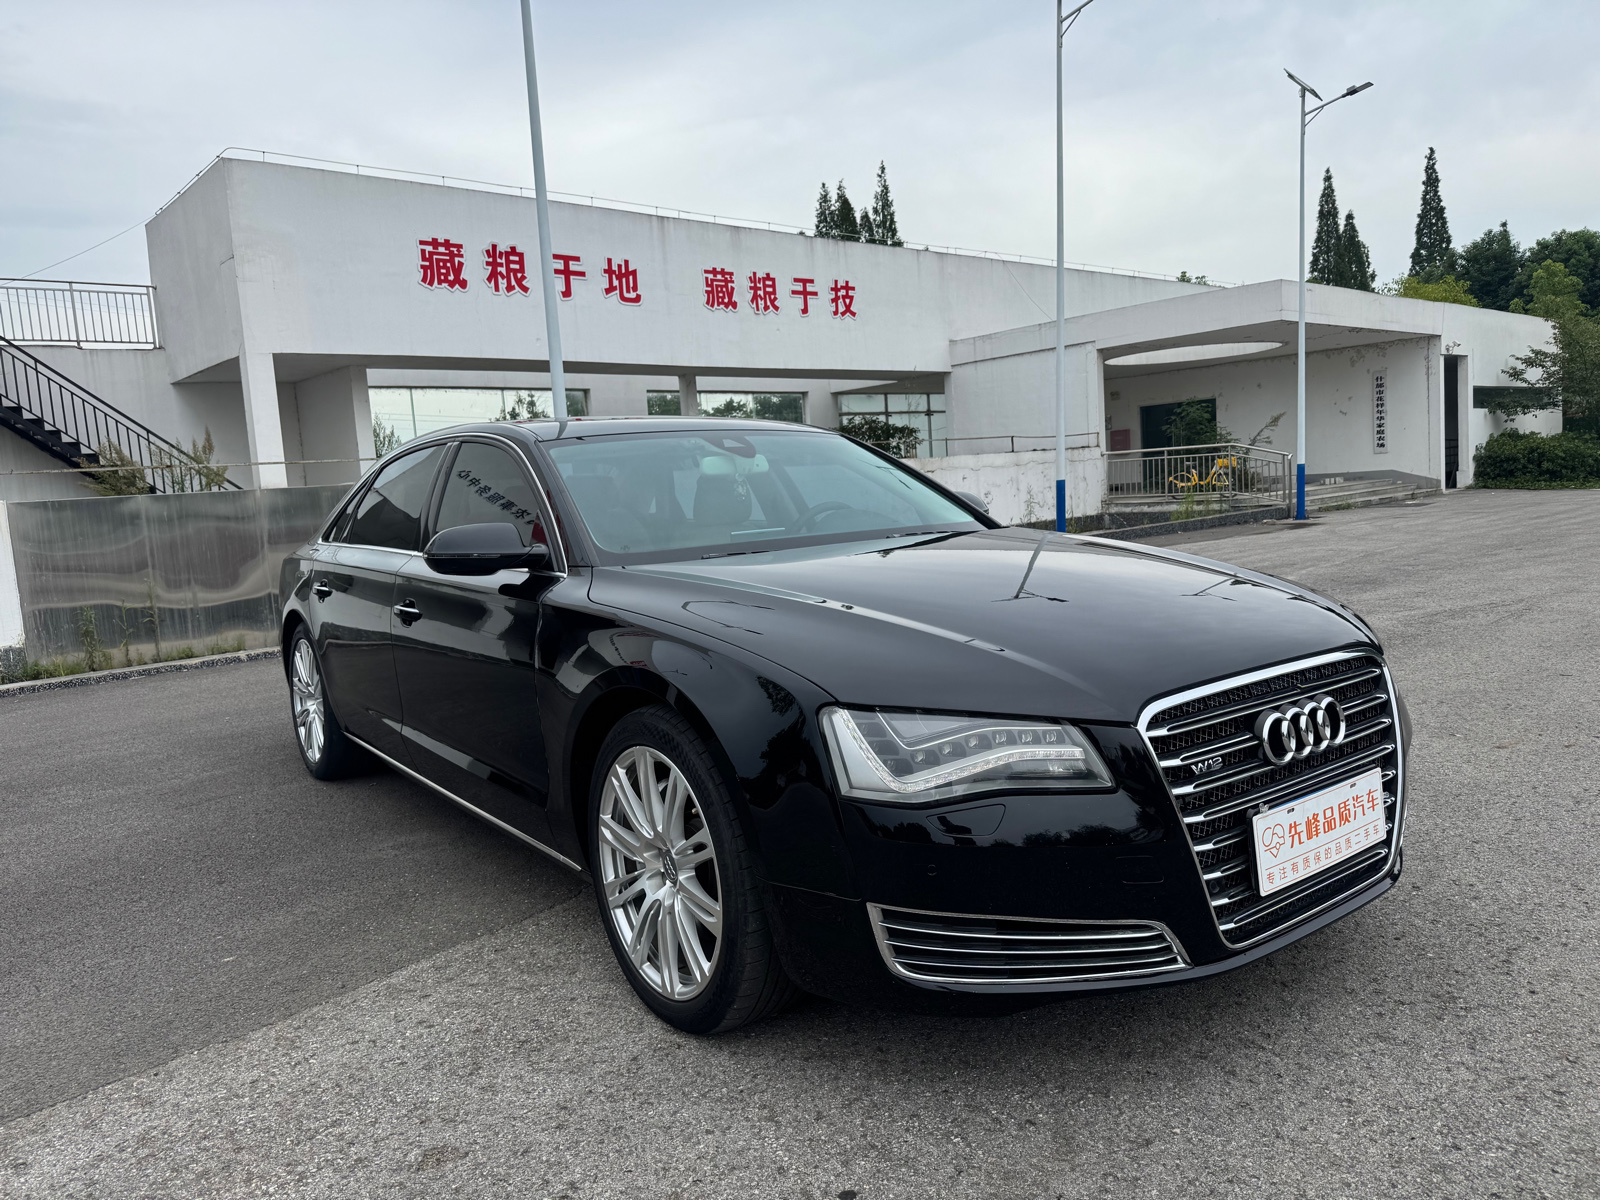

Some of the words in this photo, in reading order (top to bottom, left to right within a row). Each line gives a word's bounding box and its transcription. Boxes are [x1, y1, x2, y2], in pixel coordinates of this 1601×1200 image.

[417, 237, 642, 304] 藏粮于地
[703, 267, 858, 319] 藏粮于技
[1191, 757, 1223, 774] W12
[1288, 788, 1380, 849] 先峰品质汽车
[1266, 823, 1381, 885] 专注有质保的品质二手车
